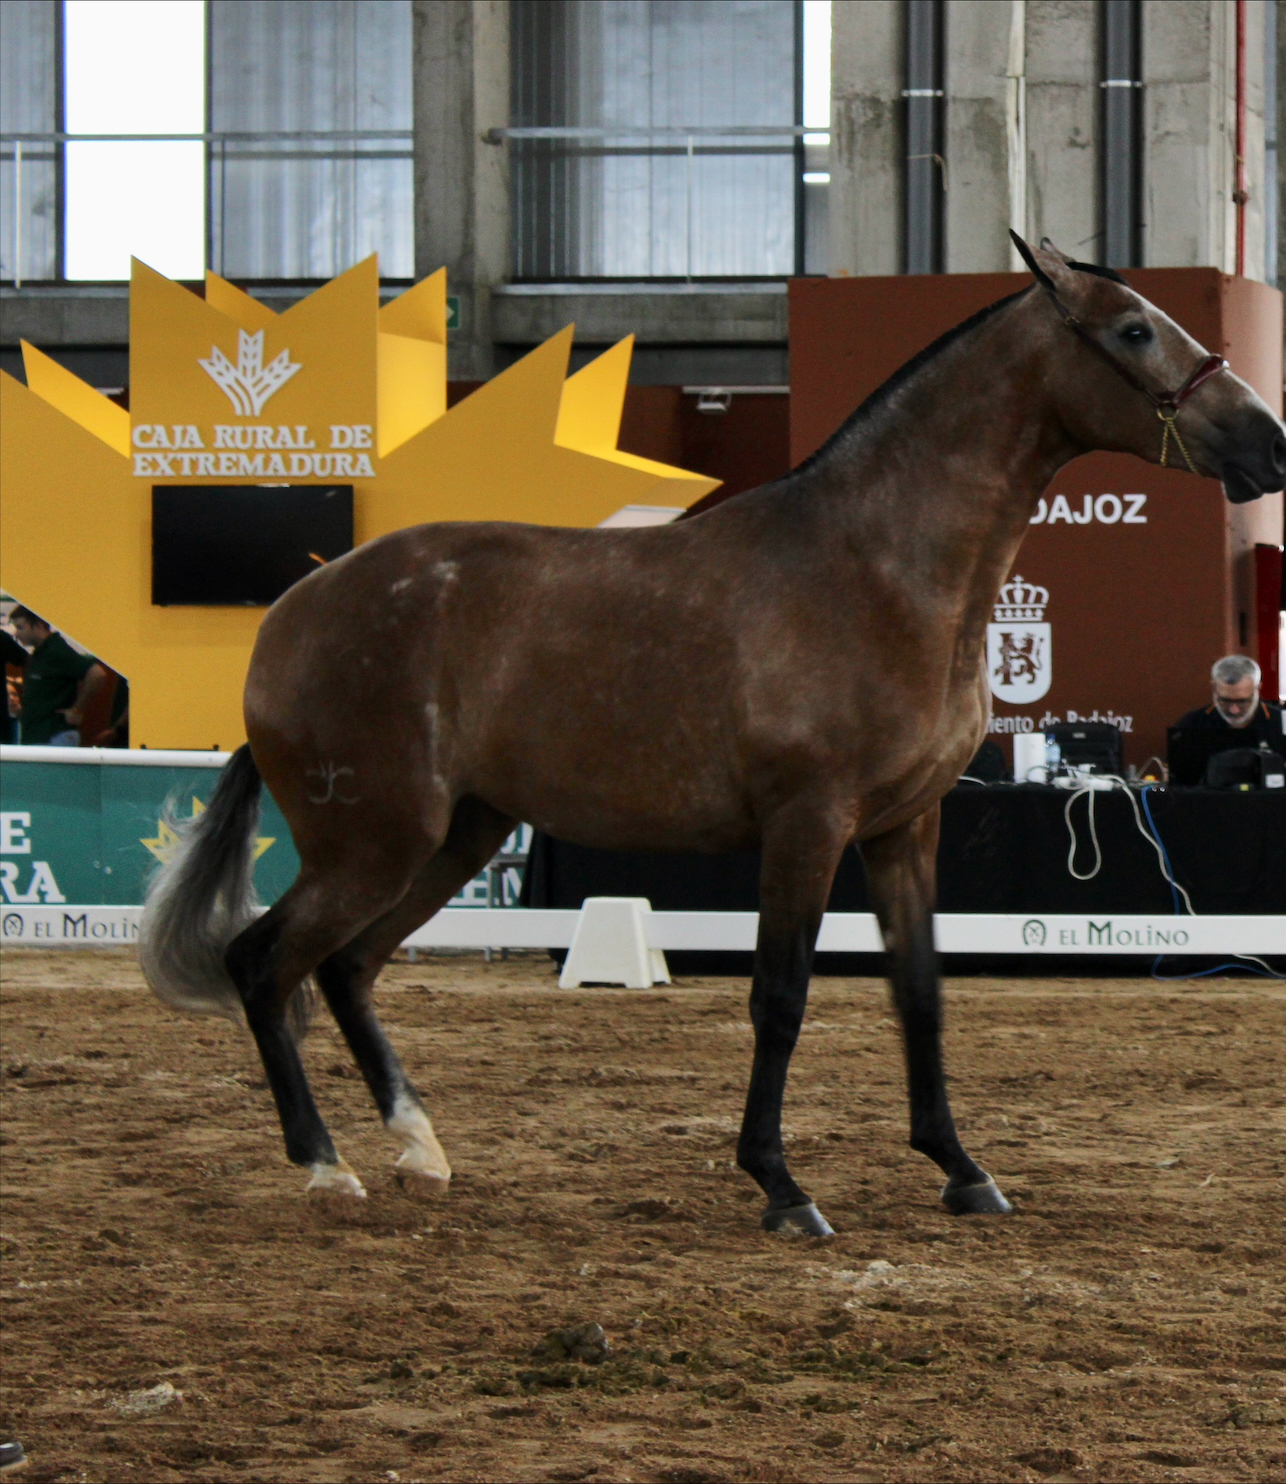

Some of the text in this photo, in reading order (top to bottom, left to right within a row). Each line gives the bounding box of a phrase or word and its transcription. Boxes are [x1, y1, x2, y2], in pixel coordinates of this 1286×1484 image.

[132, 424, 373, 450] CAJA RURAL DE
[132, 452, 376, 477] EXTREMADURA
[34, 922, 55, 938] EL
[1059, 929, 1080, 946] EL
